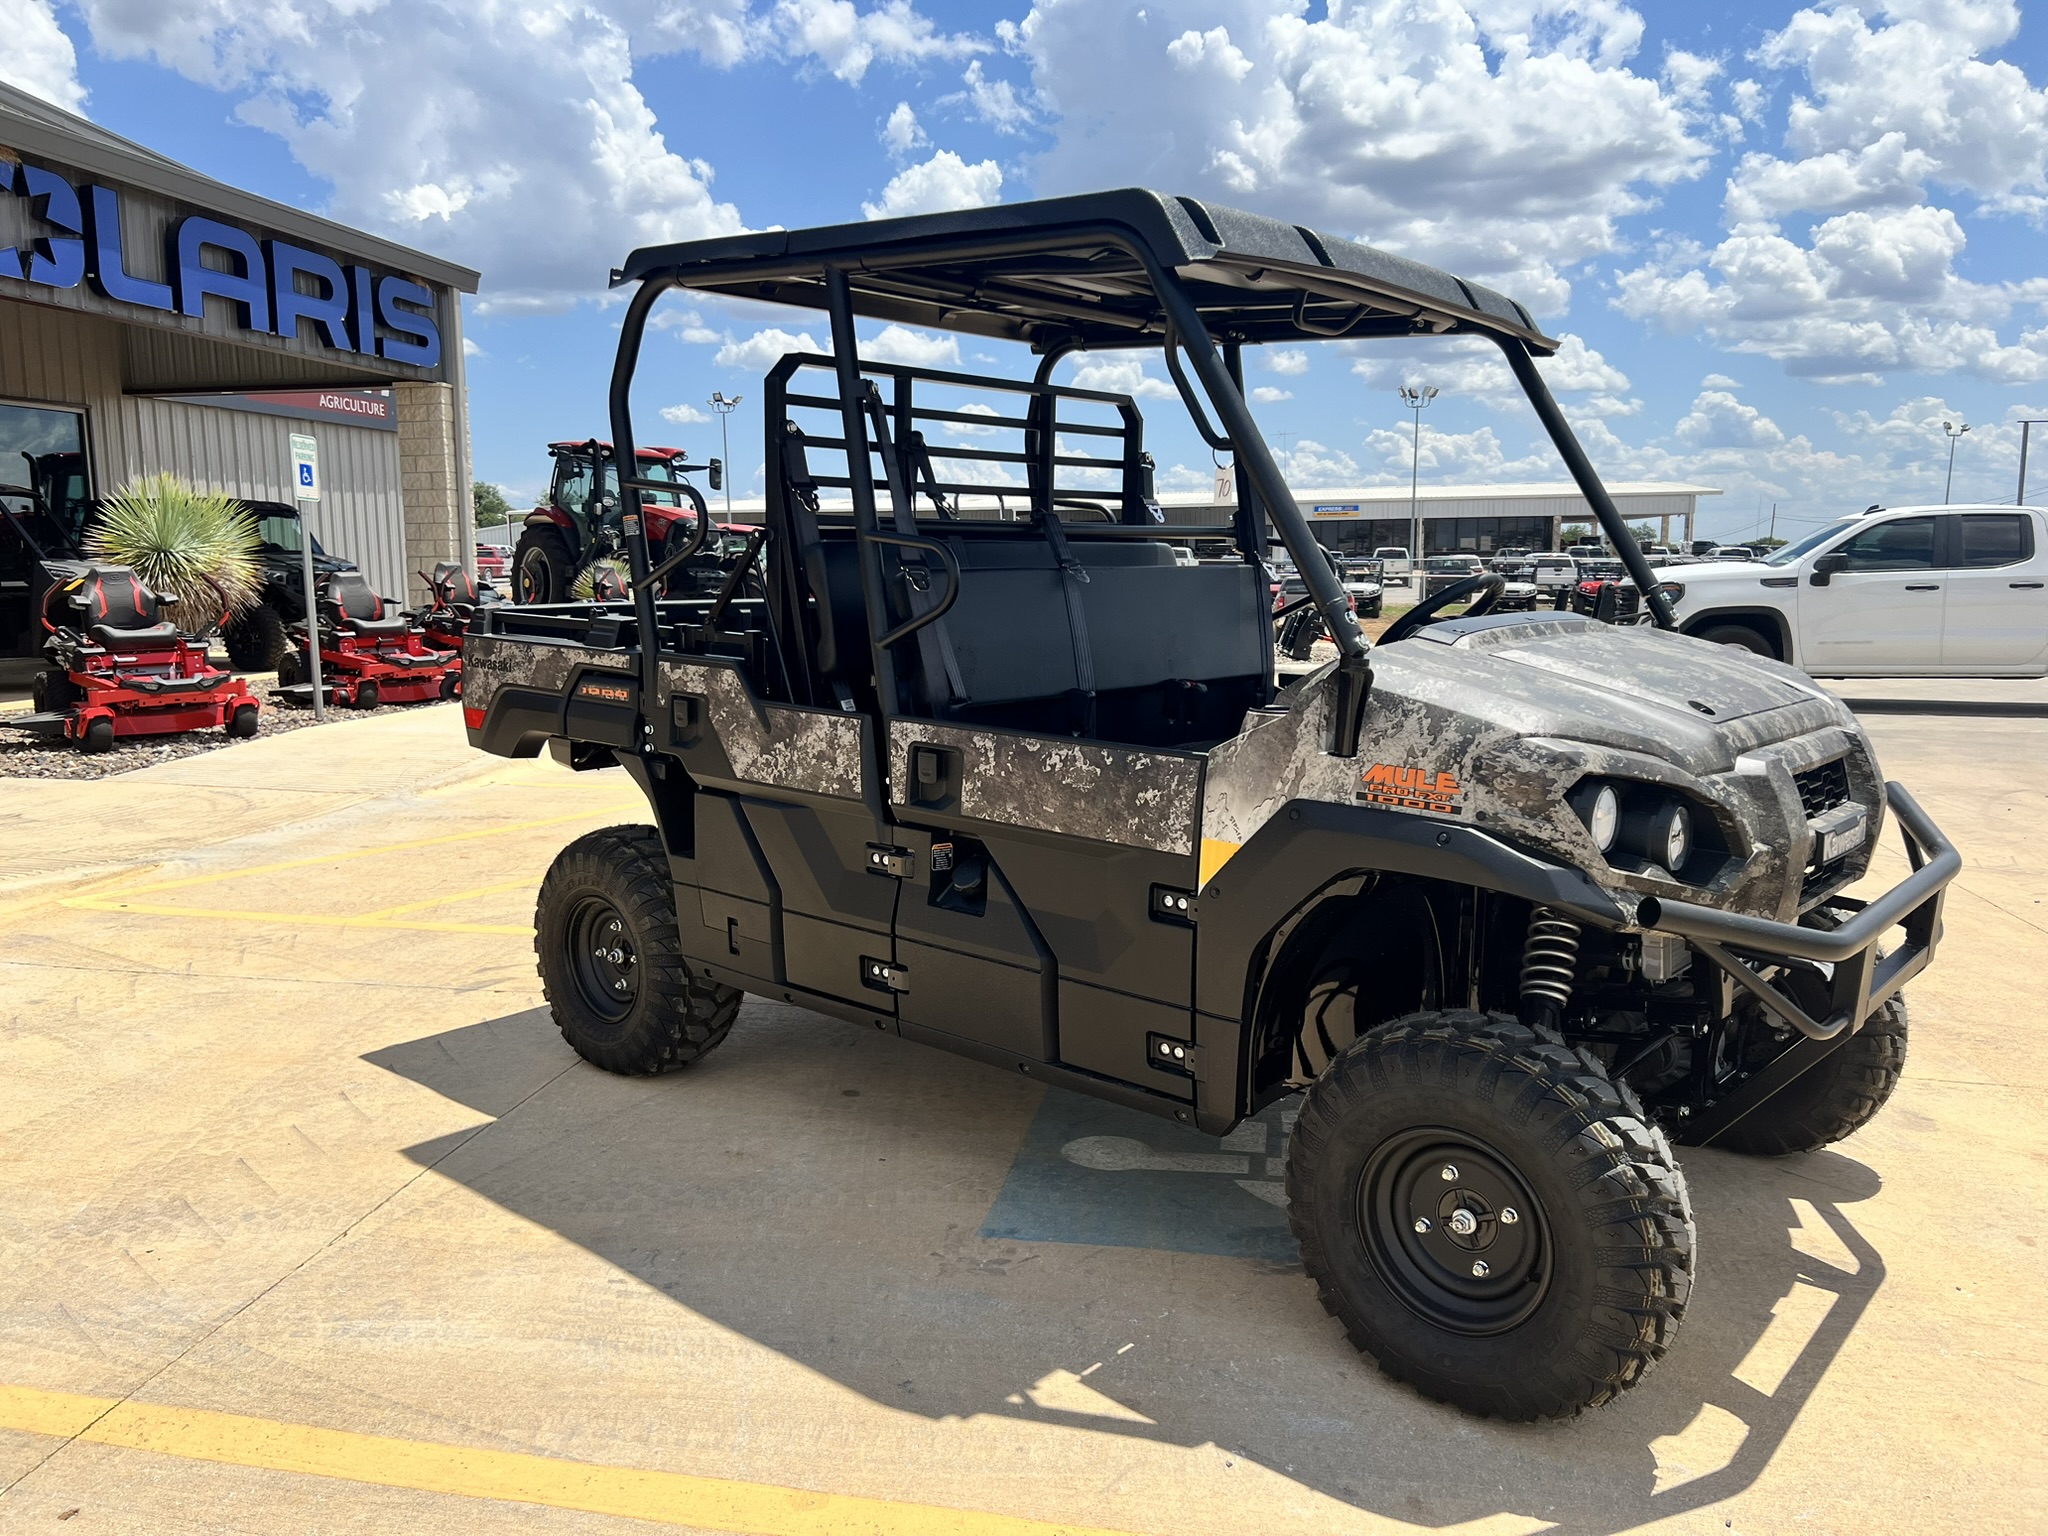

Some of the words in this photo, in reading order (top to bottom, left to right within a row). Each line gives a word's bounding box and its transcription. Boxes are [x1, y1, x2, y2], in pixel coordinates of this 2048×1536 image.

[319, 394, 386, 417] AGRICULTURE
[1216, 478, 1231, 498] 70
[468, 653, 512, 672] Kawasaki
[1362, 763, 1461, 795] MULE
[1367, 793, 1453, 814] 1000
